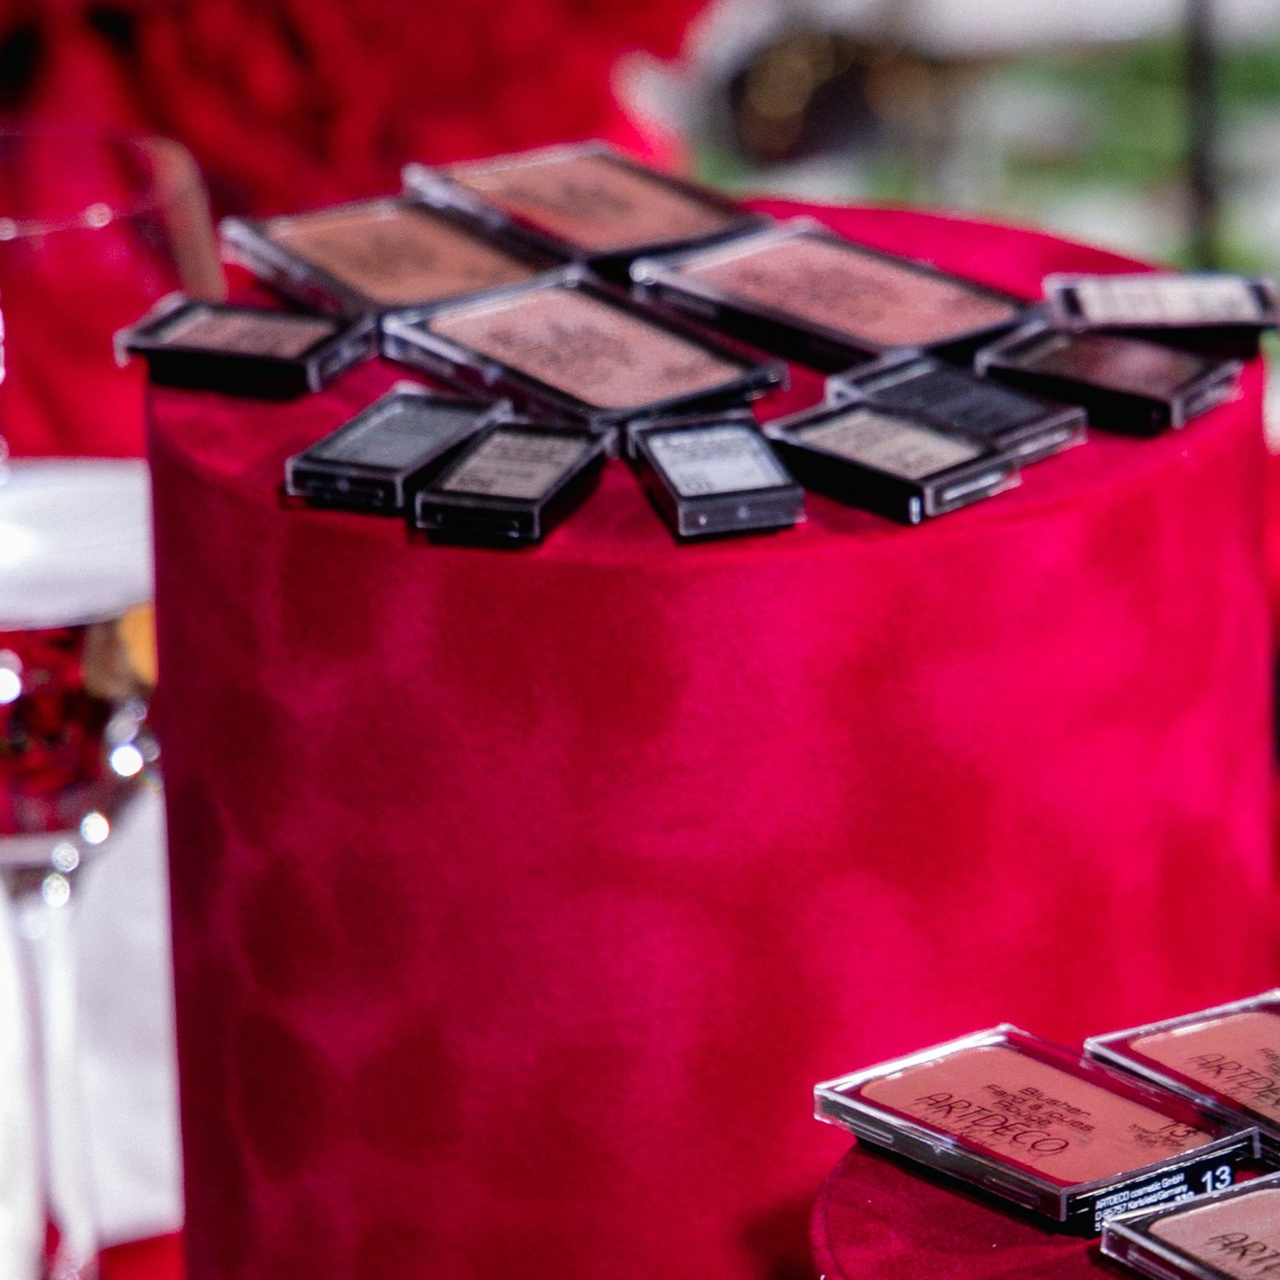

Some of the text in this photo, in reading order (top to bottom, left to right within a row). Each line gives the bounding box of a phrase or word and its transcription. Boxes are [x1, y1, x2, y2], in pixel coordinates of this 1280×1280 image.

[984, 1084, 1030, 1103] Fard
[1019, 1086, 1091, 1117] Blusher
[915, 1092, 1069, 1152] ARTDECO
[993, 1100, 1051, 1125] Rouge
[1162, 1173, 1185, 1189] GmbH
[1201, 1166, 1232, 1193] 13
